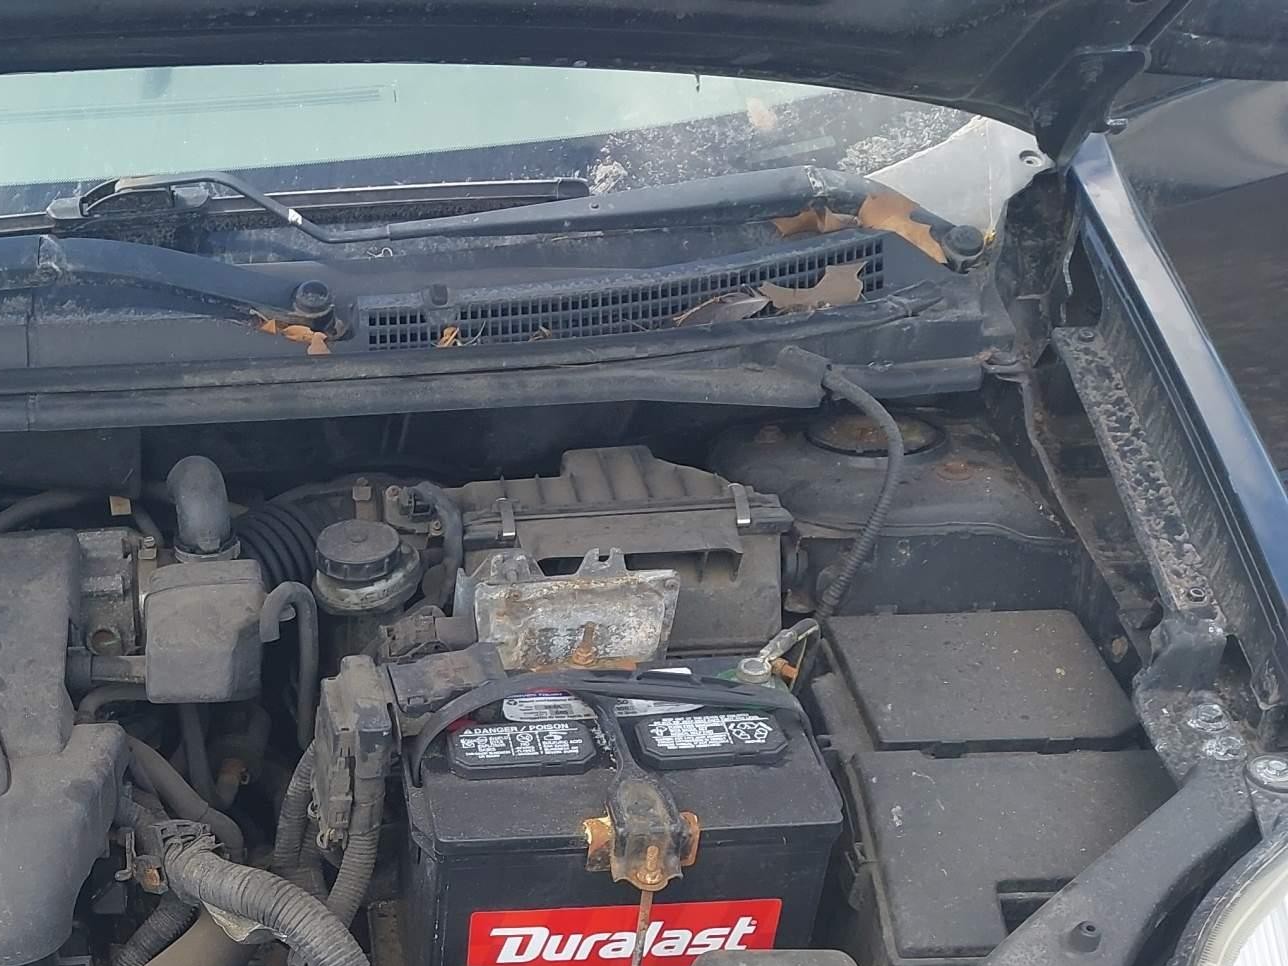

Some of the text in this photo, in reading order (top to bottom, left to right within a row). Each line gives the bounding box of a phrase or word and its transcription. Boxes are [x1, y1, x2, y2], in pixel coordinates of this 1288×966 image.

[474, 726, 518, 734] DANGER
[529, 723, 569, 731] POISON
[489, 916, 757, 964] Duralast
